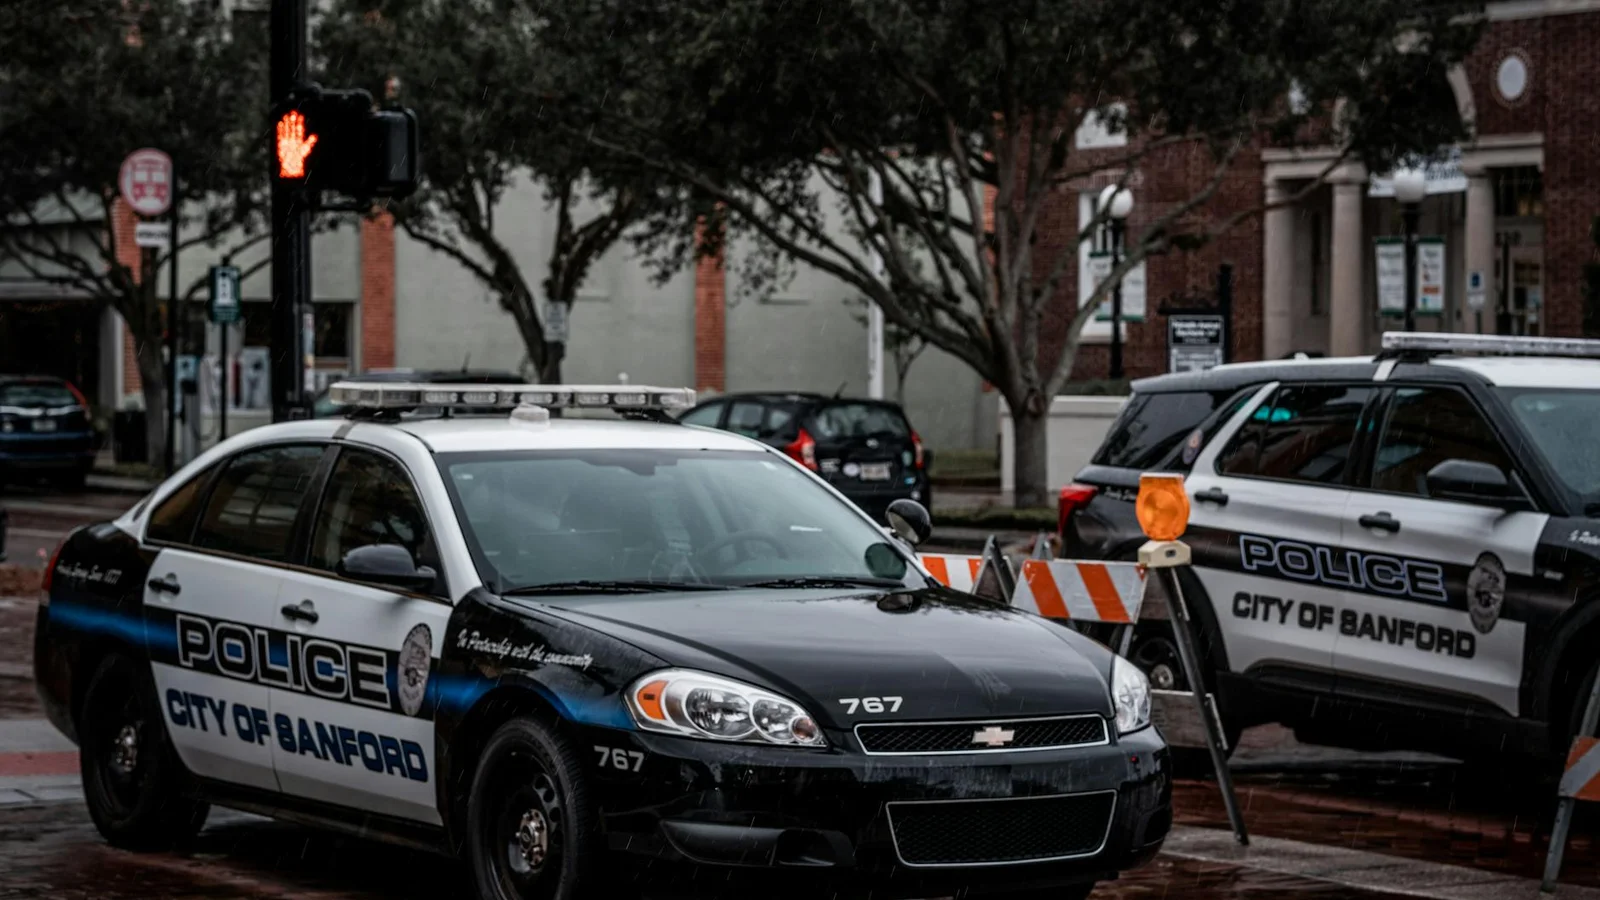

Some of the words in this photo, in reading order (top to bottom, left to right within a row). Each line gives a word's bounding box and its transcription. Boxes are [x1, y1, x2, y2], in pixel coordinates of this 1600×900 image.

[1239, 534, 1447, 600] POLICE
[1232, 591, 1293, 624] CITY
[1297, 601, 1334, 630] OF
[1340, 608, 1476, 659] SANFORD
[175, 613, 391, 709] POLICE
[165, 688, 227, 736] CITY
[232, 703, 271, 745] OF
[275, 713, 429, 782] SANFORD
[839, 696, 903, 715] 767
[593, 745, 645, 773] 767
